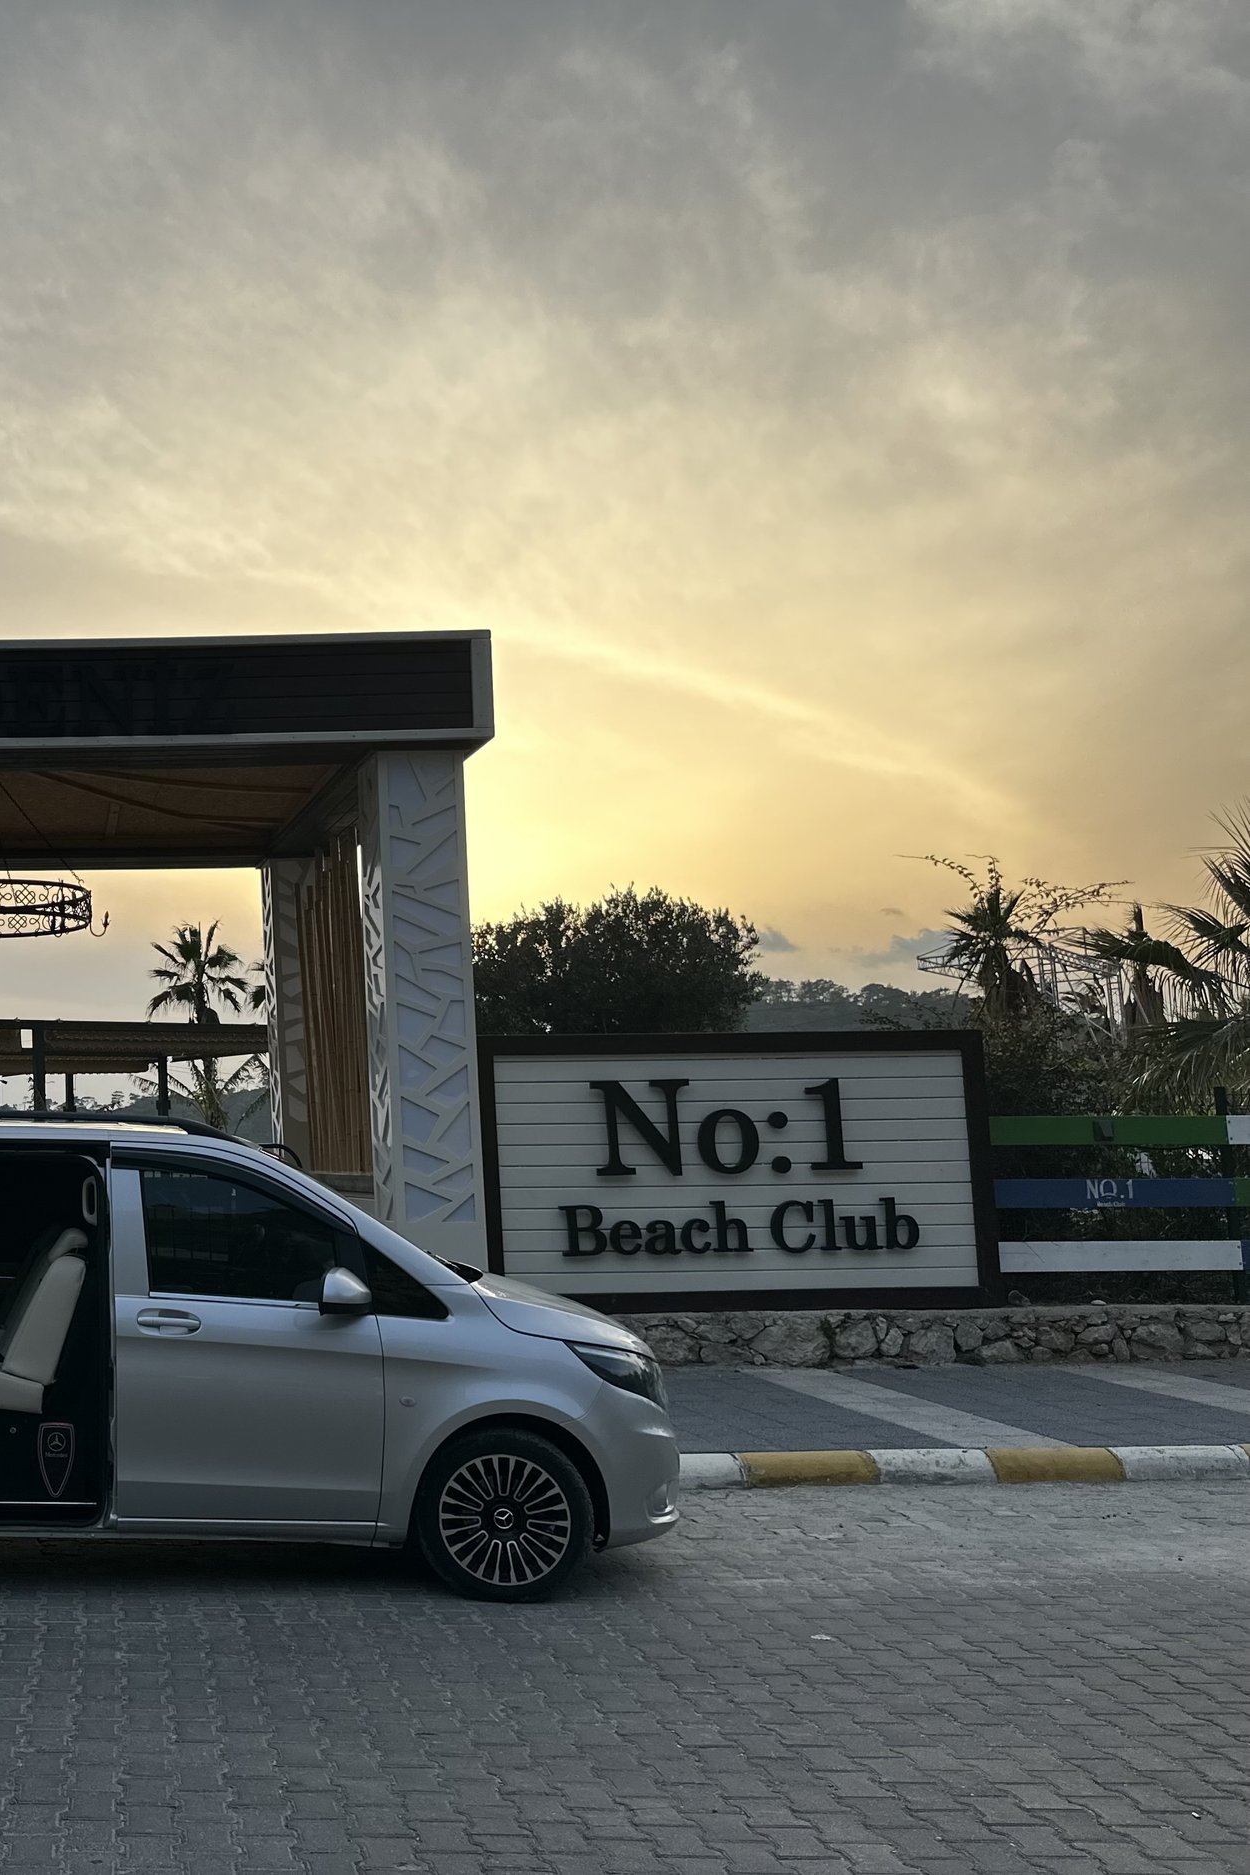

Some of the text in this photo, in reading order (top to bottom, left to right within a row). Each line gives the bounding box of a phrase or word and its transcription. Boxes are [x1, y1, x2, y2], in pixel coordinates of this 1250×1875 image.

[588, 1077, 864, 1177] No:1
[558, 1197, 920, 1257] Beach Club
